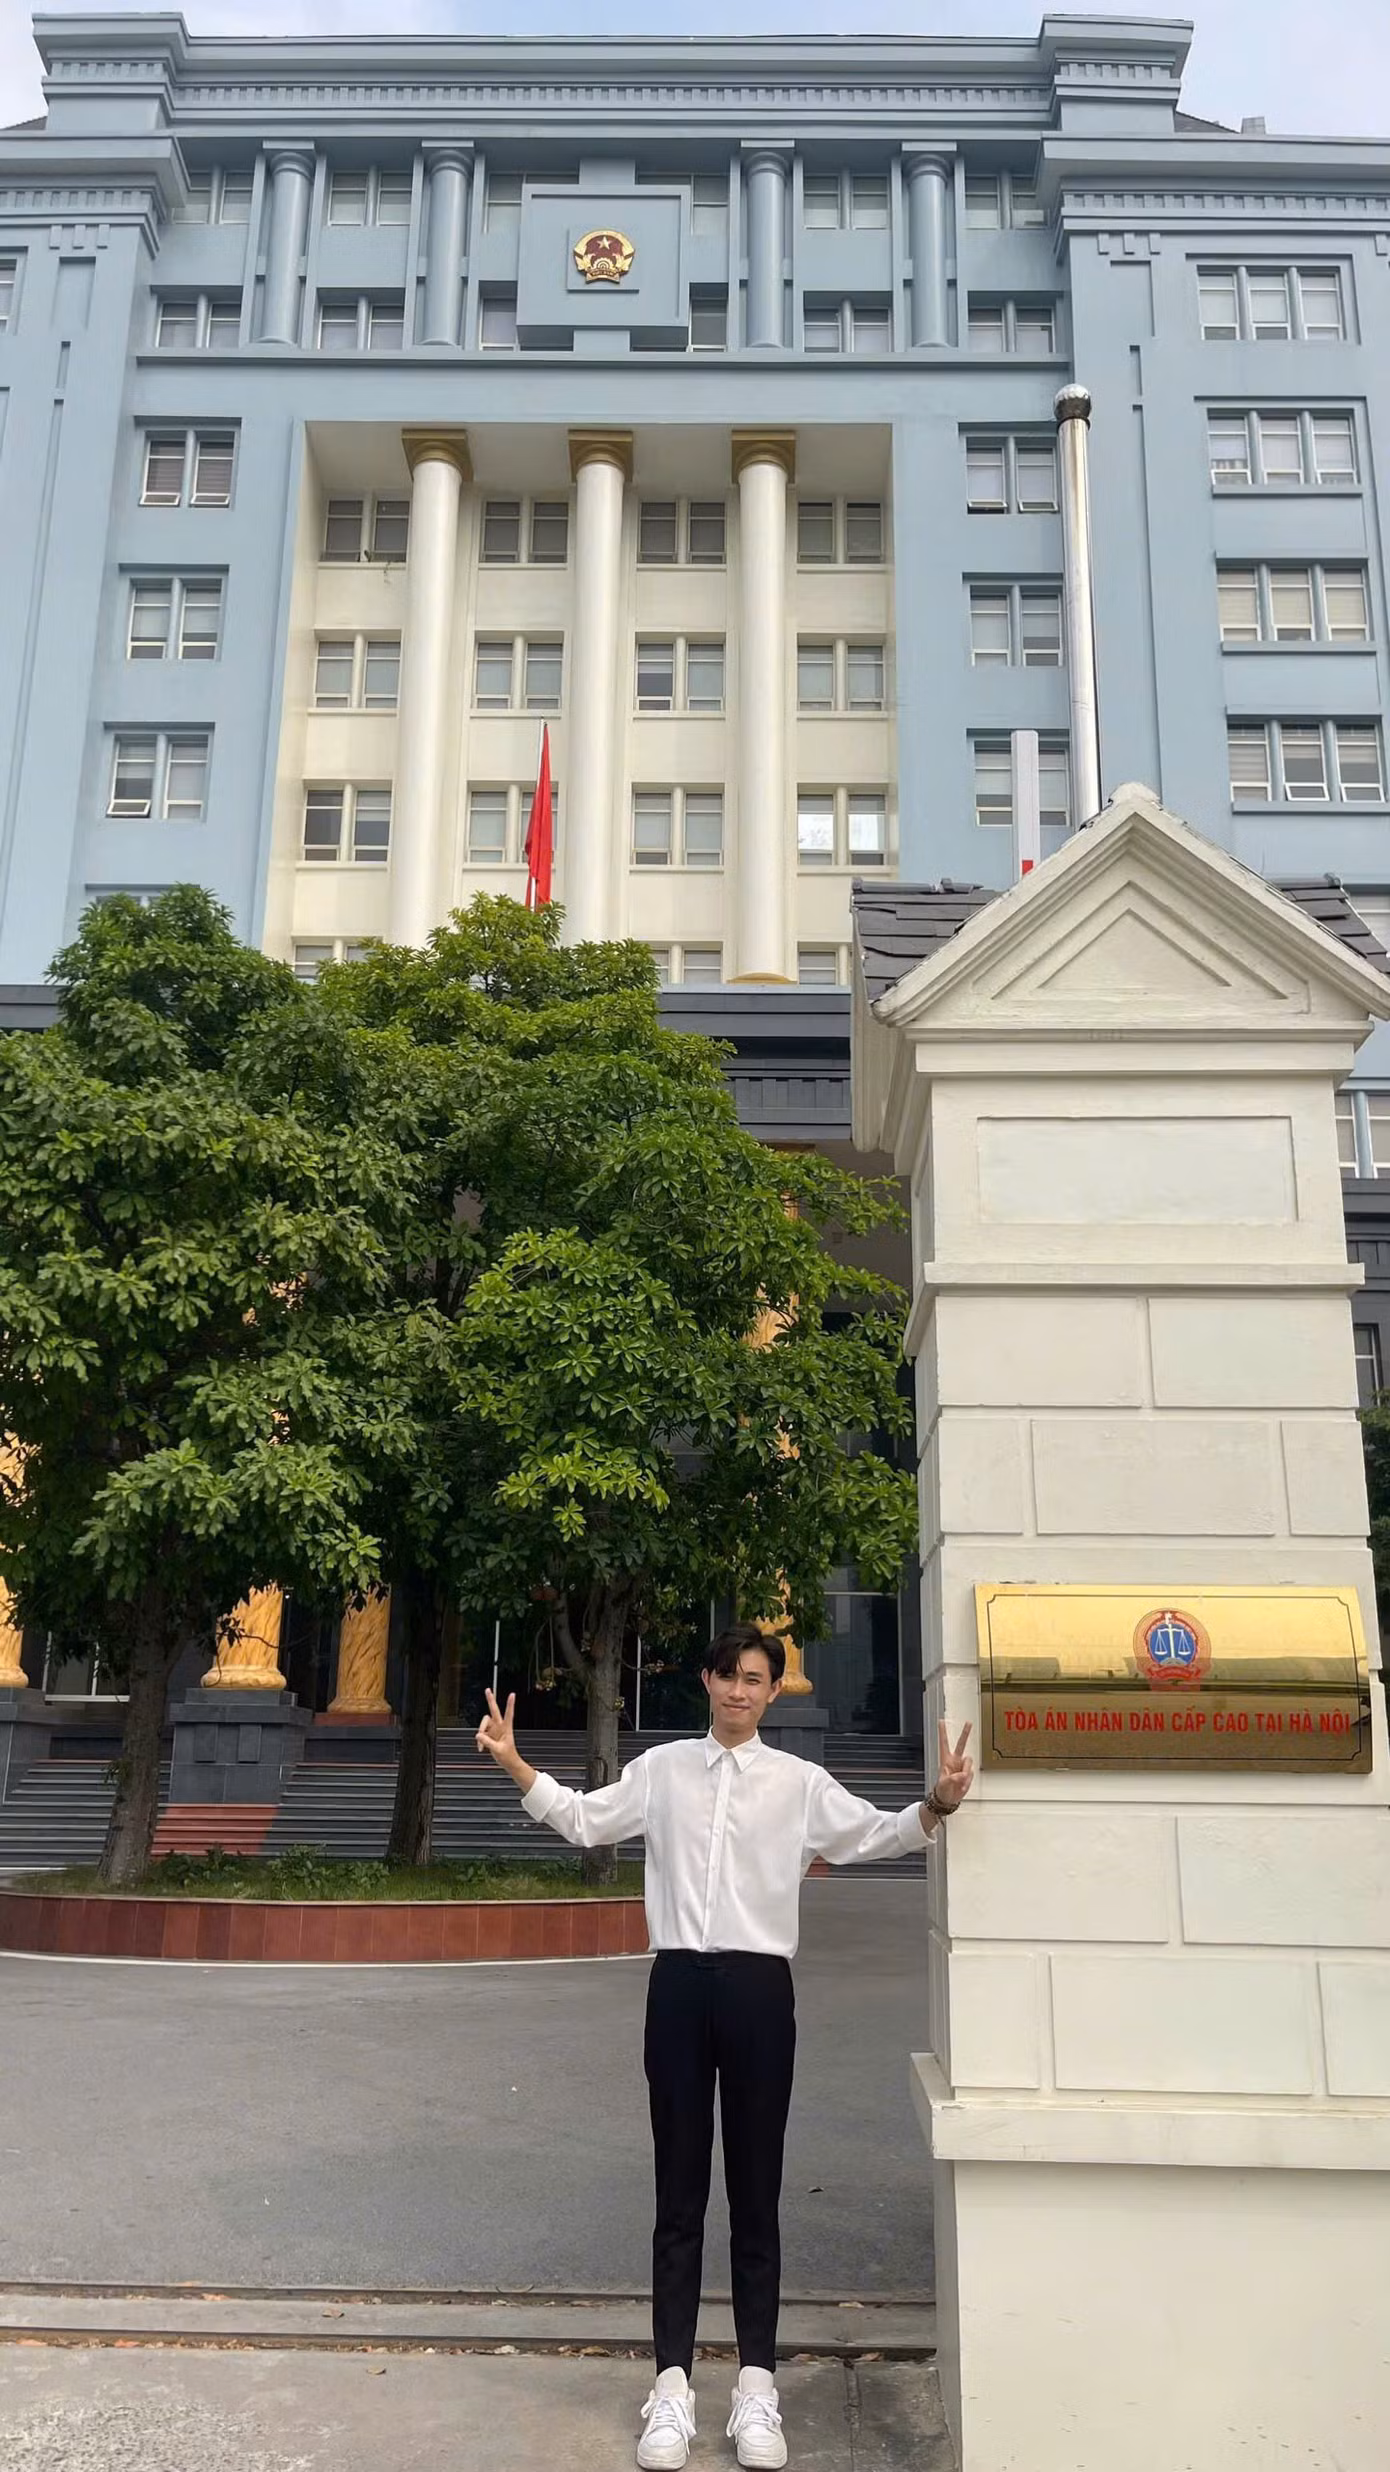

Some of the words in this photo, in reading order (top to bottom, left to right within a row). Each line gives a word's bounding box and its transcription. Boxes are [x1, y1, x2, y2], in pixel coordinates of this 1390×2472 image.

[1004, 1705, 1038, 1731] TÒA
[1045, 1706, 1068, 1731] ÁN
[1075, 1706, 1122, 1731] NHÂN
[1129, 1707, 1164, 1732] DÂN
[1171, 1705, 1206, 1732] CẤP
[1213, 1712, 1249, 1733] CAO
[1255, 1712, 1282, 1736] TẠI
[1289, 1708, 1313, 1733] HÀ
[1319, 1708, 1350, 1737] NỘI
